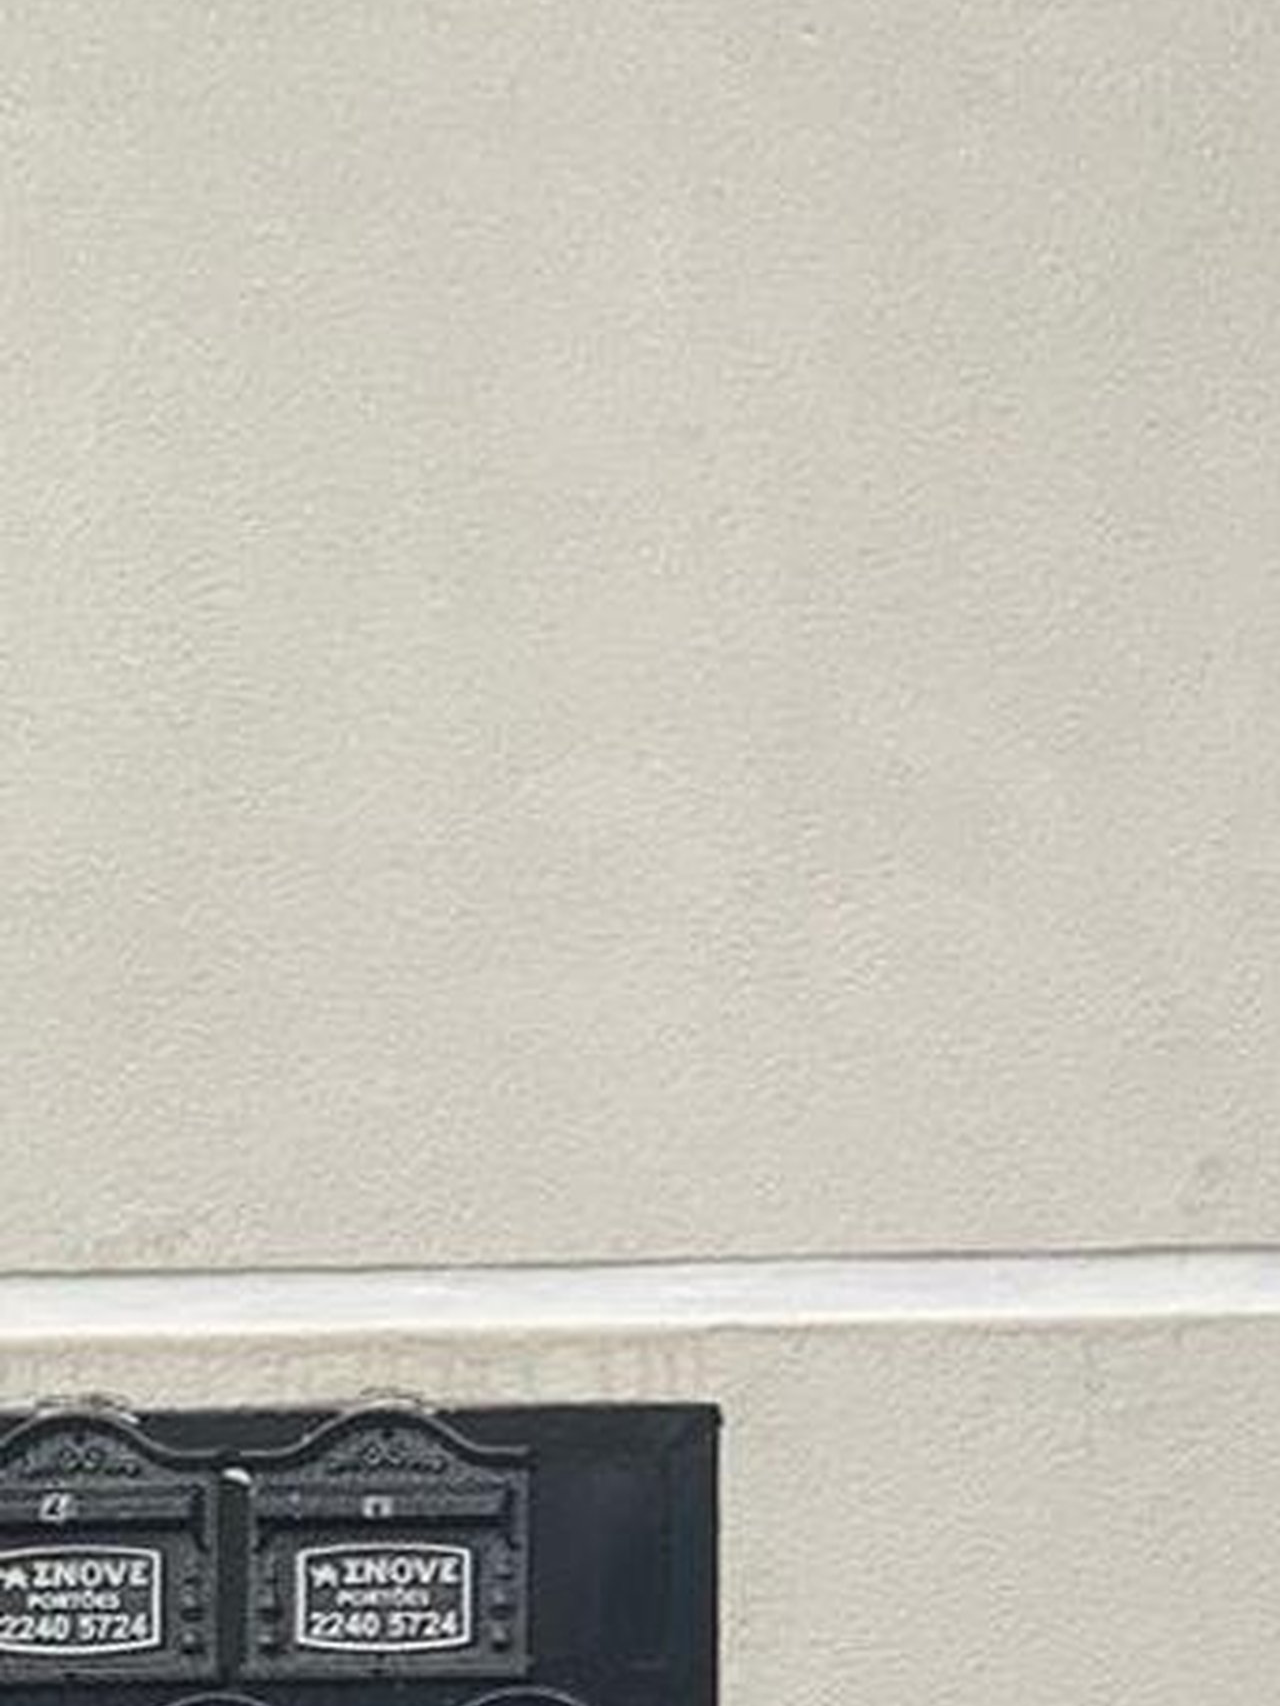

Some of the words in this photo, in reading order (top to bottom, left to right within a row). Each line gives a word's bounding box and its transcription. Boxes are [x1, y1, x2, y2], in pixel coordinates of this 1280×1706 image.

[33, 1558, 150, 1588] INOVE
[343, 1555, 460, 1584] INOVE
[76, 1613, 149, 1640] 5724
[310, 1611, 381, 1638] 2240
[387, 1610, 458, 1637] 5724
